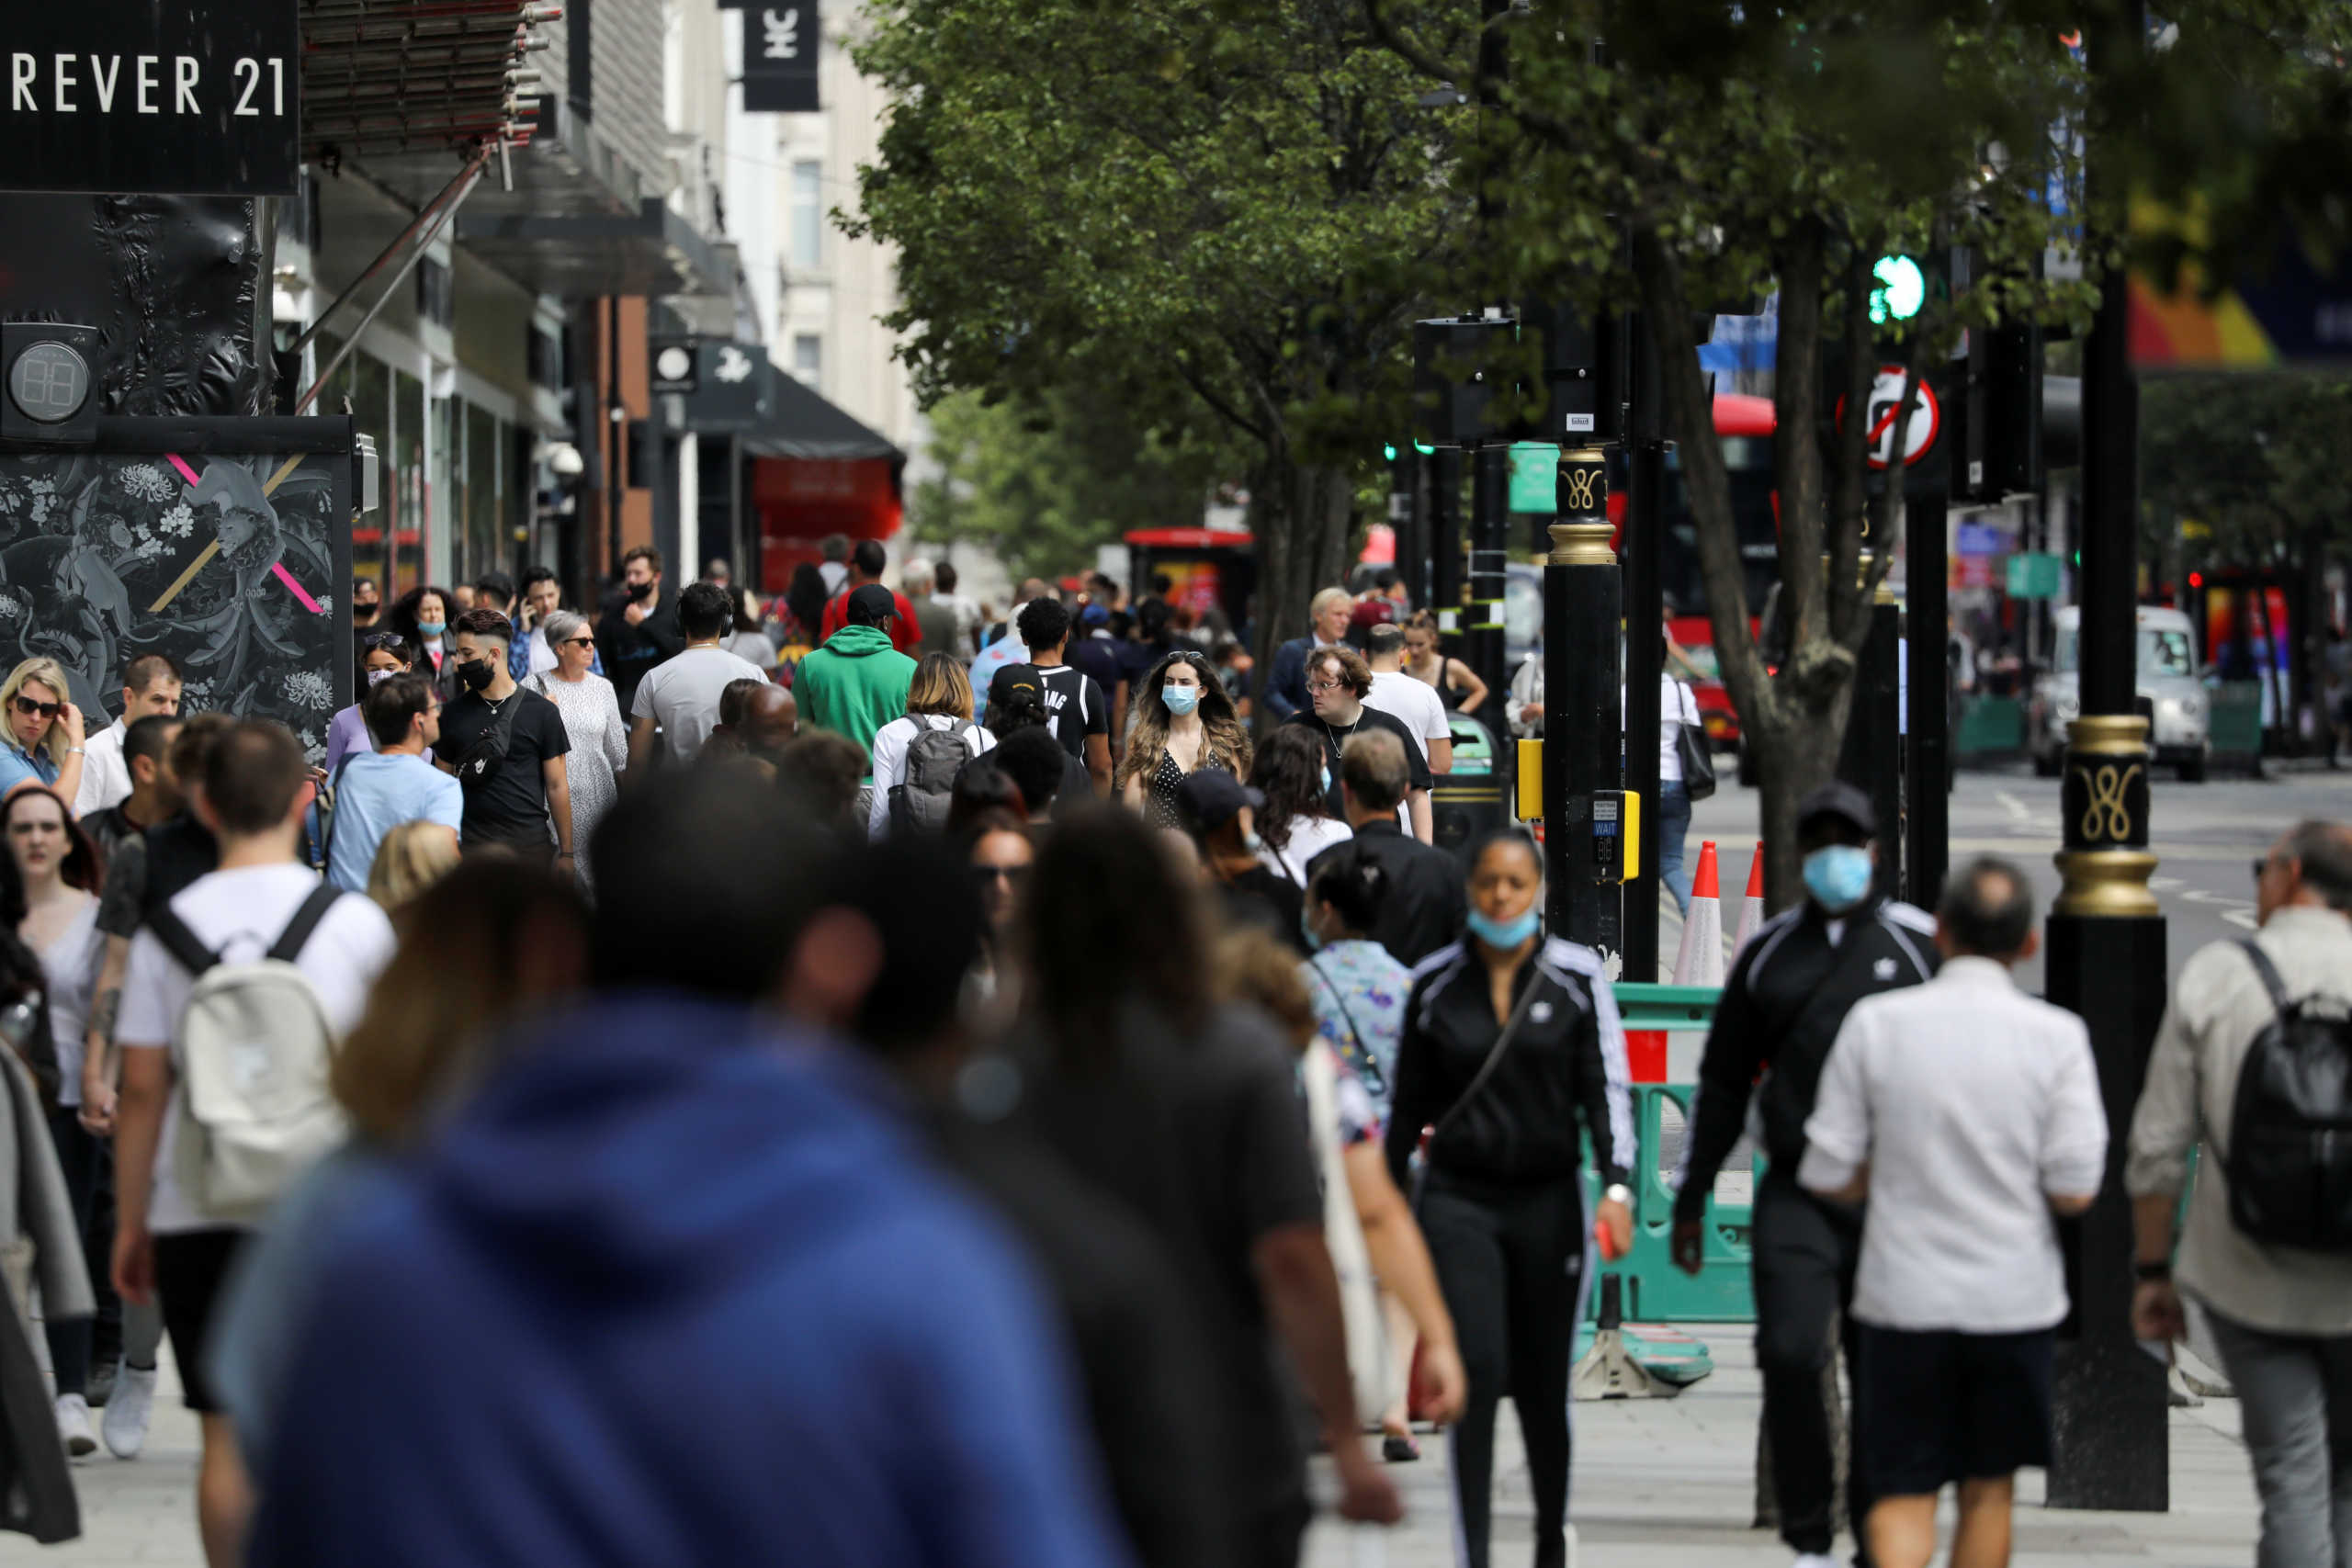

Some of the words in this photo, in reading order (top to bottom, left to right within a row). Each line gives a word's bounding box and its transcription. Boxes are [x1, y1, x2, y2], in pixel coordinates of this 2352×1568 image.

[12, 52, 202, 114] REVER
[233, 57, 284, 116] 21
[1595, 822, 1616, 836] WAIT
